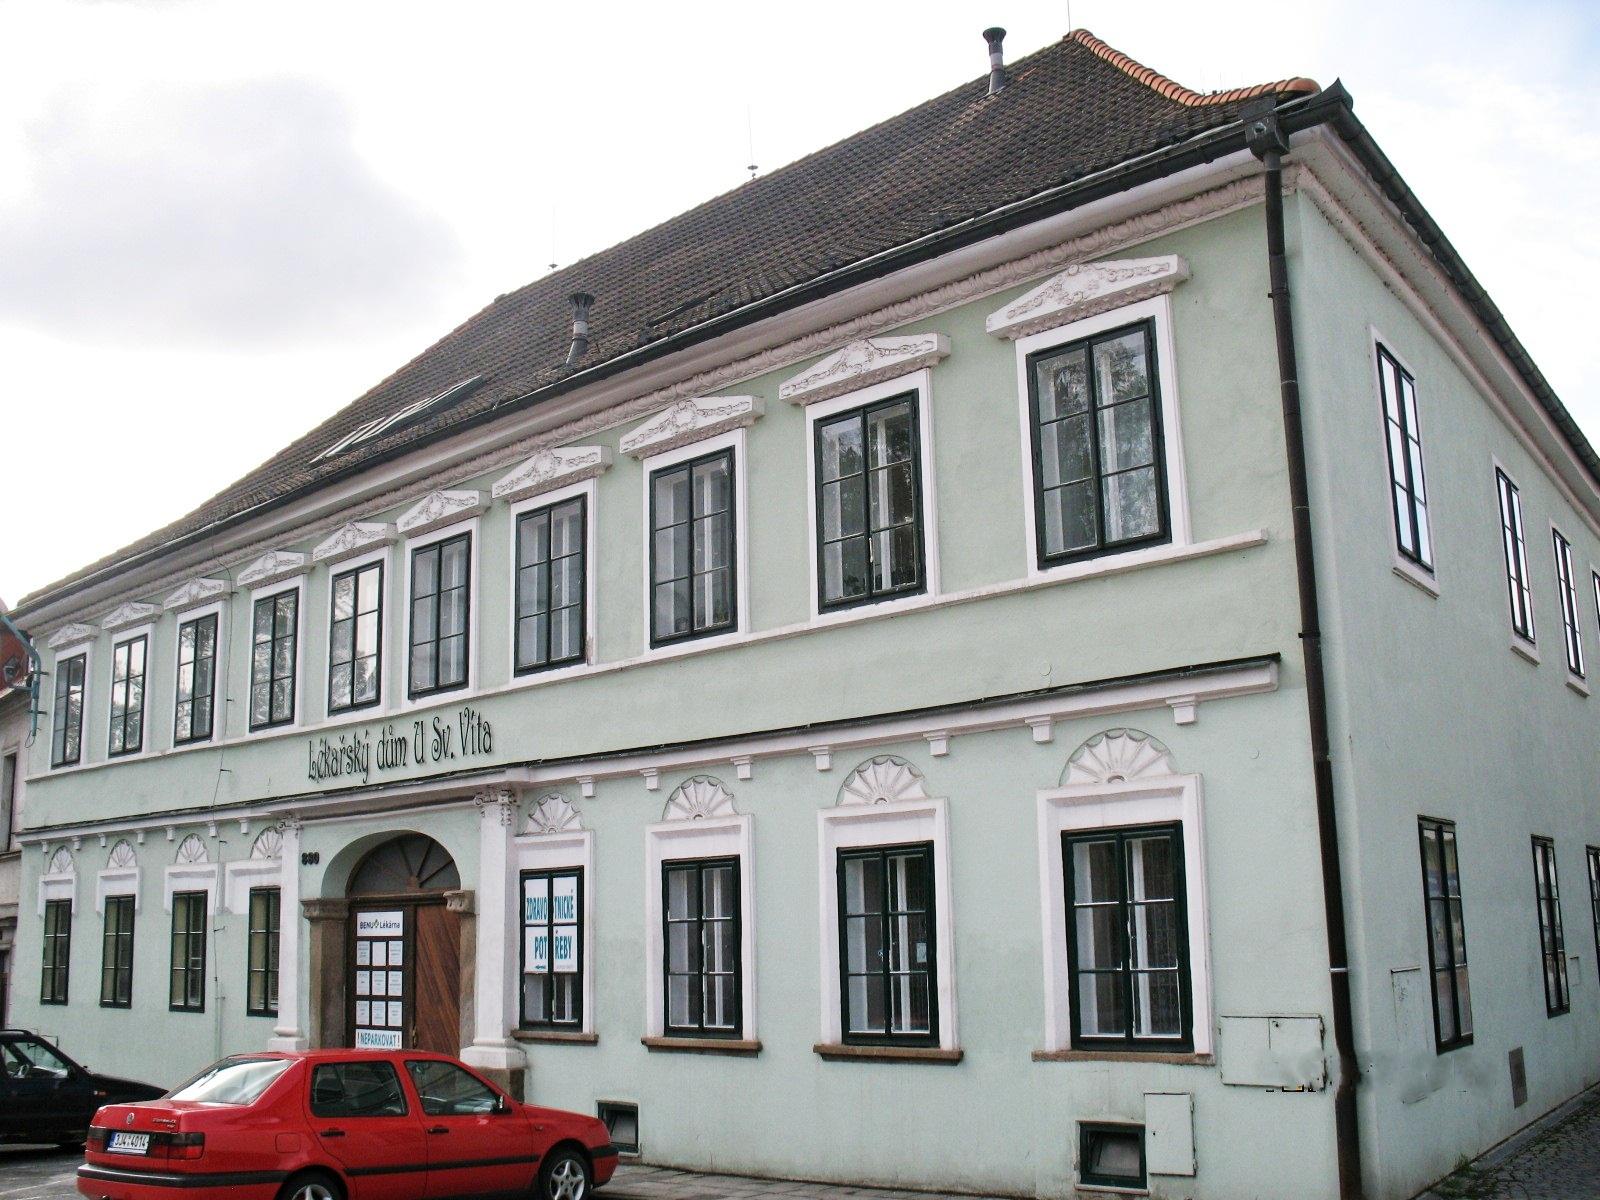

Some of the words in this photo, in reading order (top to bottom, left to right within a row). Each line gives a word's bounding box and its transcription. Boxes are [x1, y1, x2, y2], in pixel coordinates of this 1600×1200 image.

[308, 728, 370, 784] Lékařský
[376, 724, 408, 771] dům
[431, 716, 455, 761] Sv.
[459, 706, 493, 756] Víta
[379, 920, 401, 929] Lékárna
